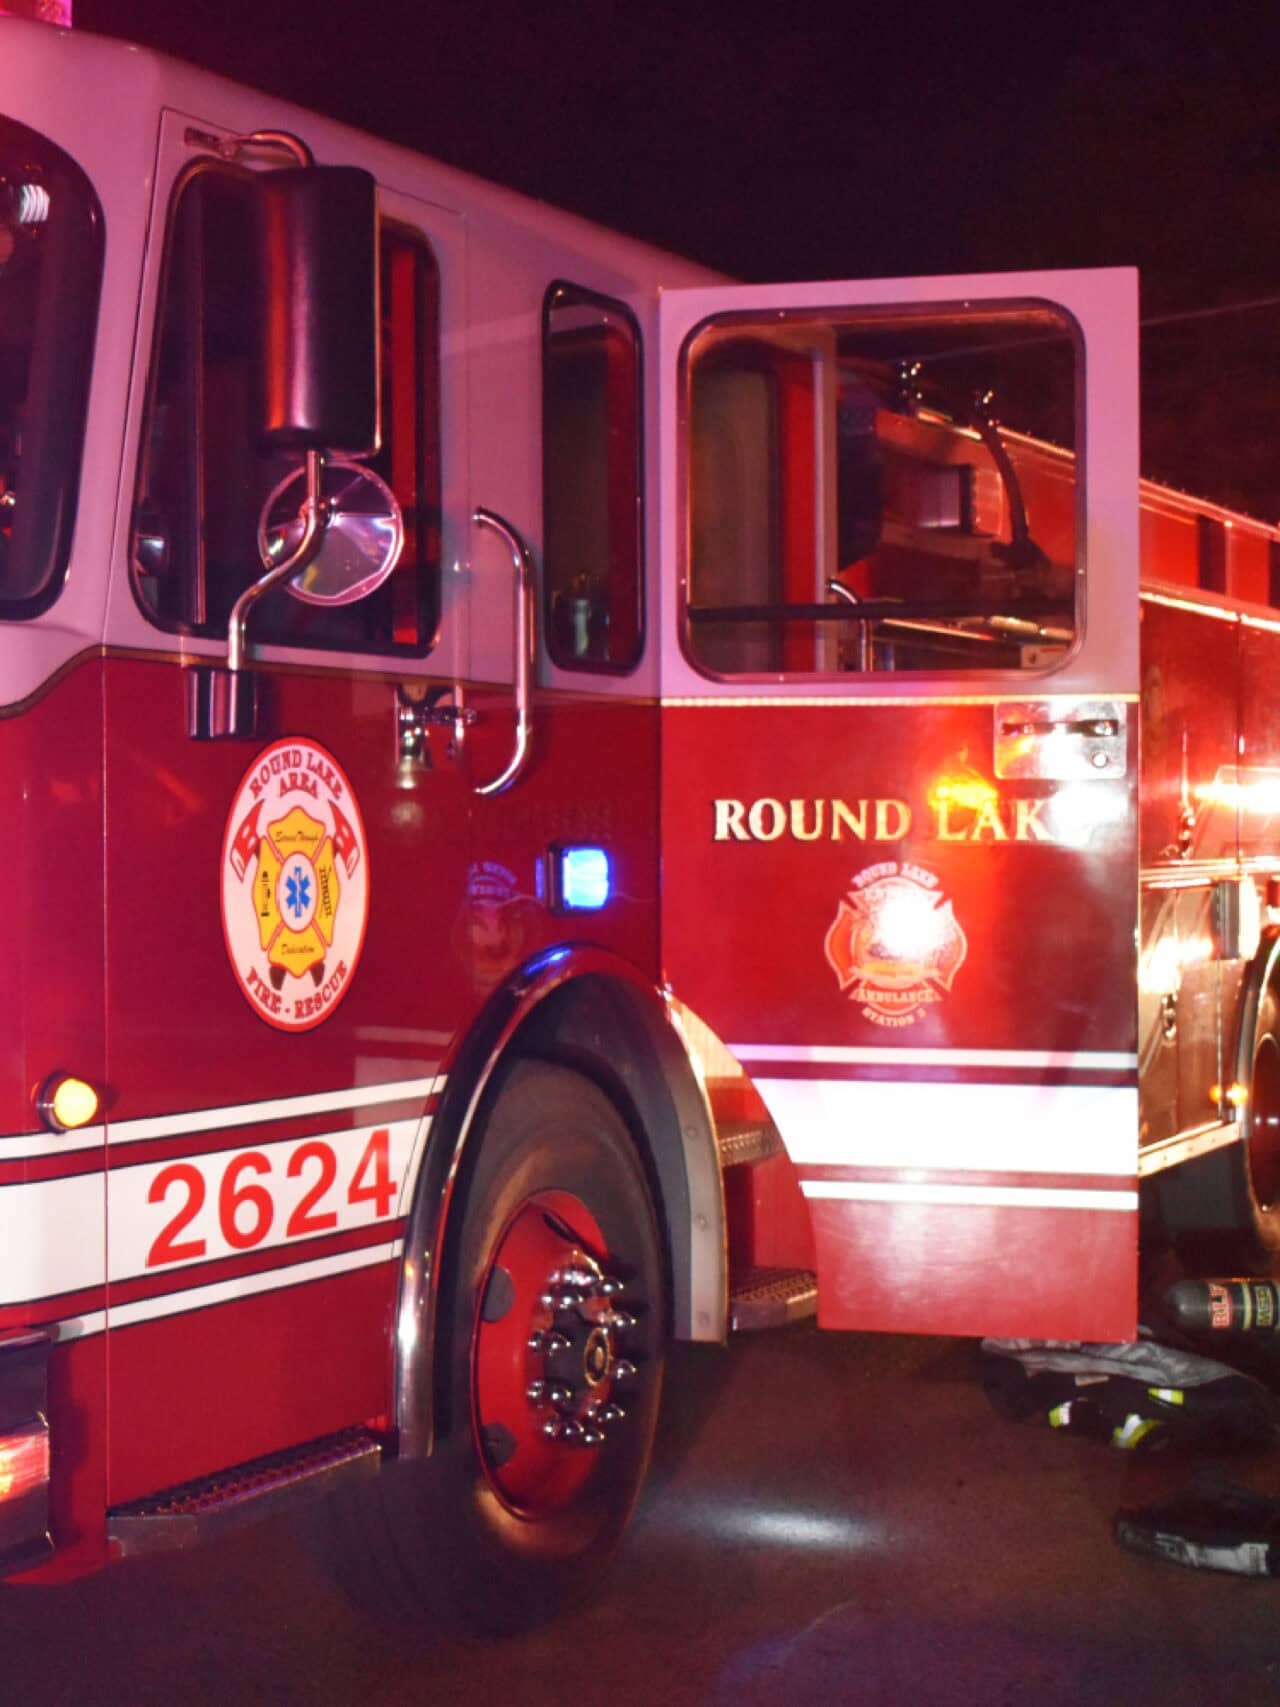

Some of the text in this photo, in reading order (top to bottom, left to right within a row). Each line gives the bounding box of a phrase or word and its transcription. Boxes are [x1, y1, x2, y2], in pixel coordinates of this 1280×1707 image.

[249, 749, 343, 800] ROUND LAKE
[279, 772, 318, 799] AREA
[713, 798, 1091, 842] ROUND LAK
[246, 960, 347, 1019] FIRE RESCUE
[144, 1127, 398, 1269] 2624
